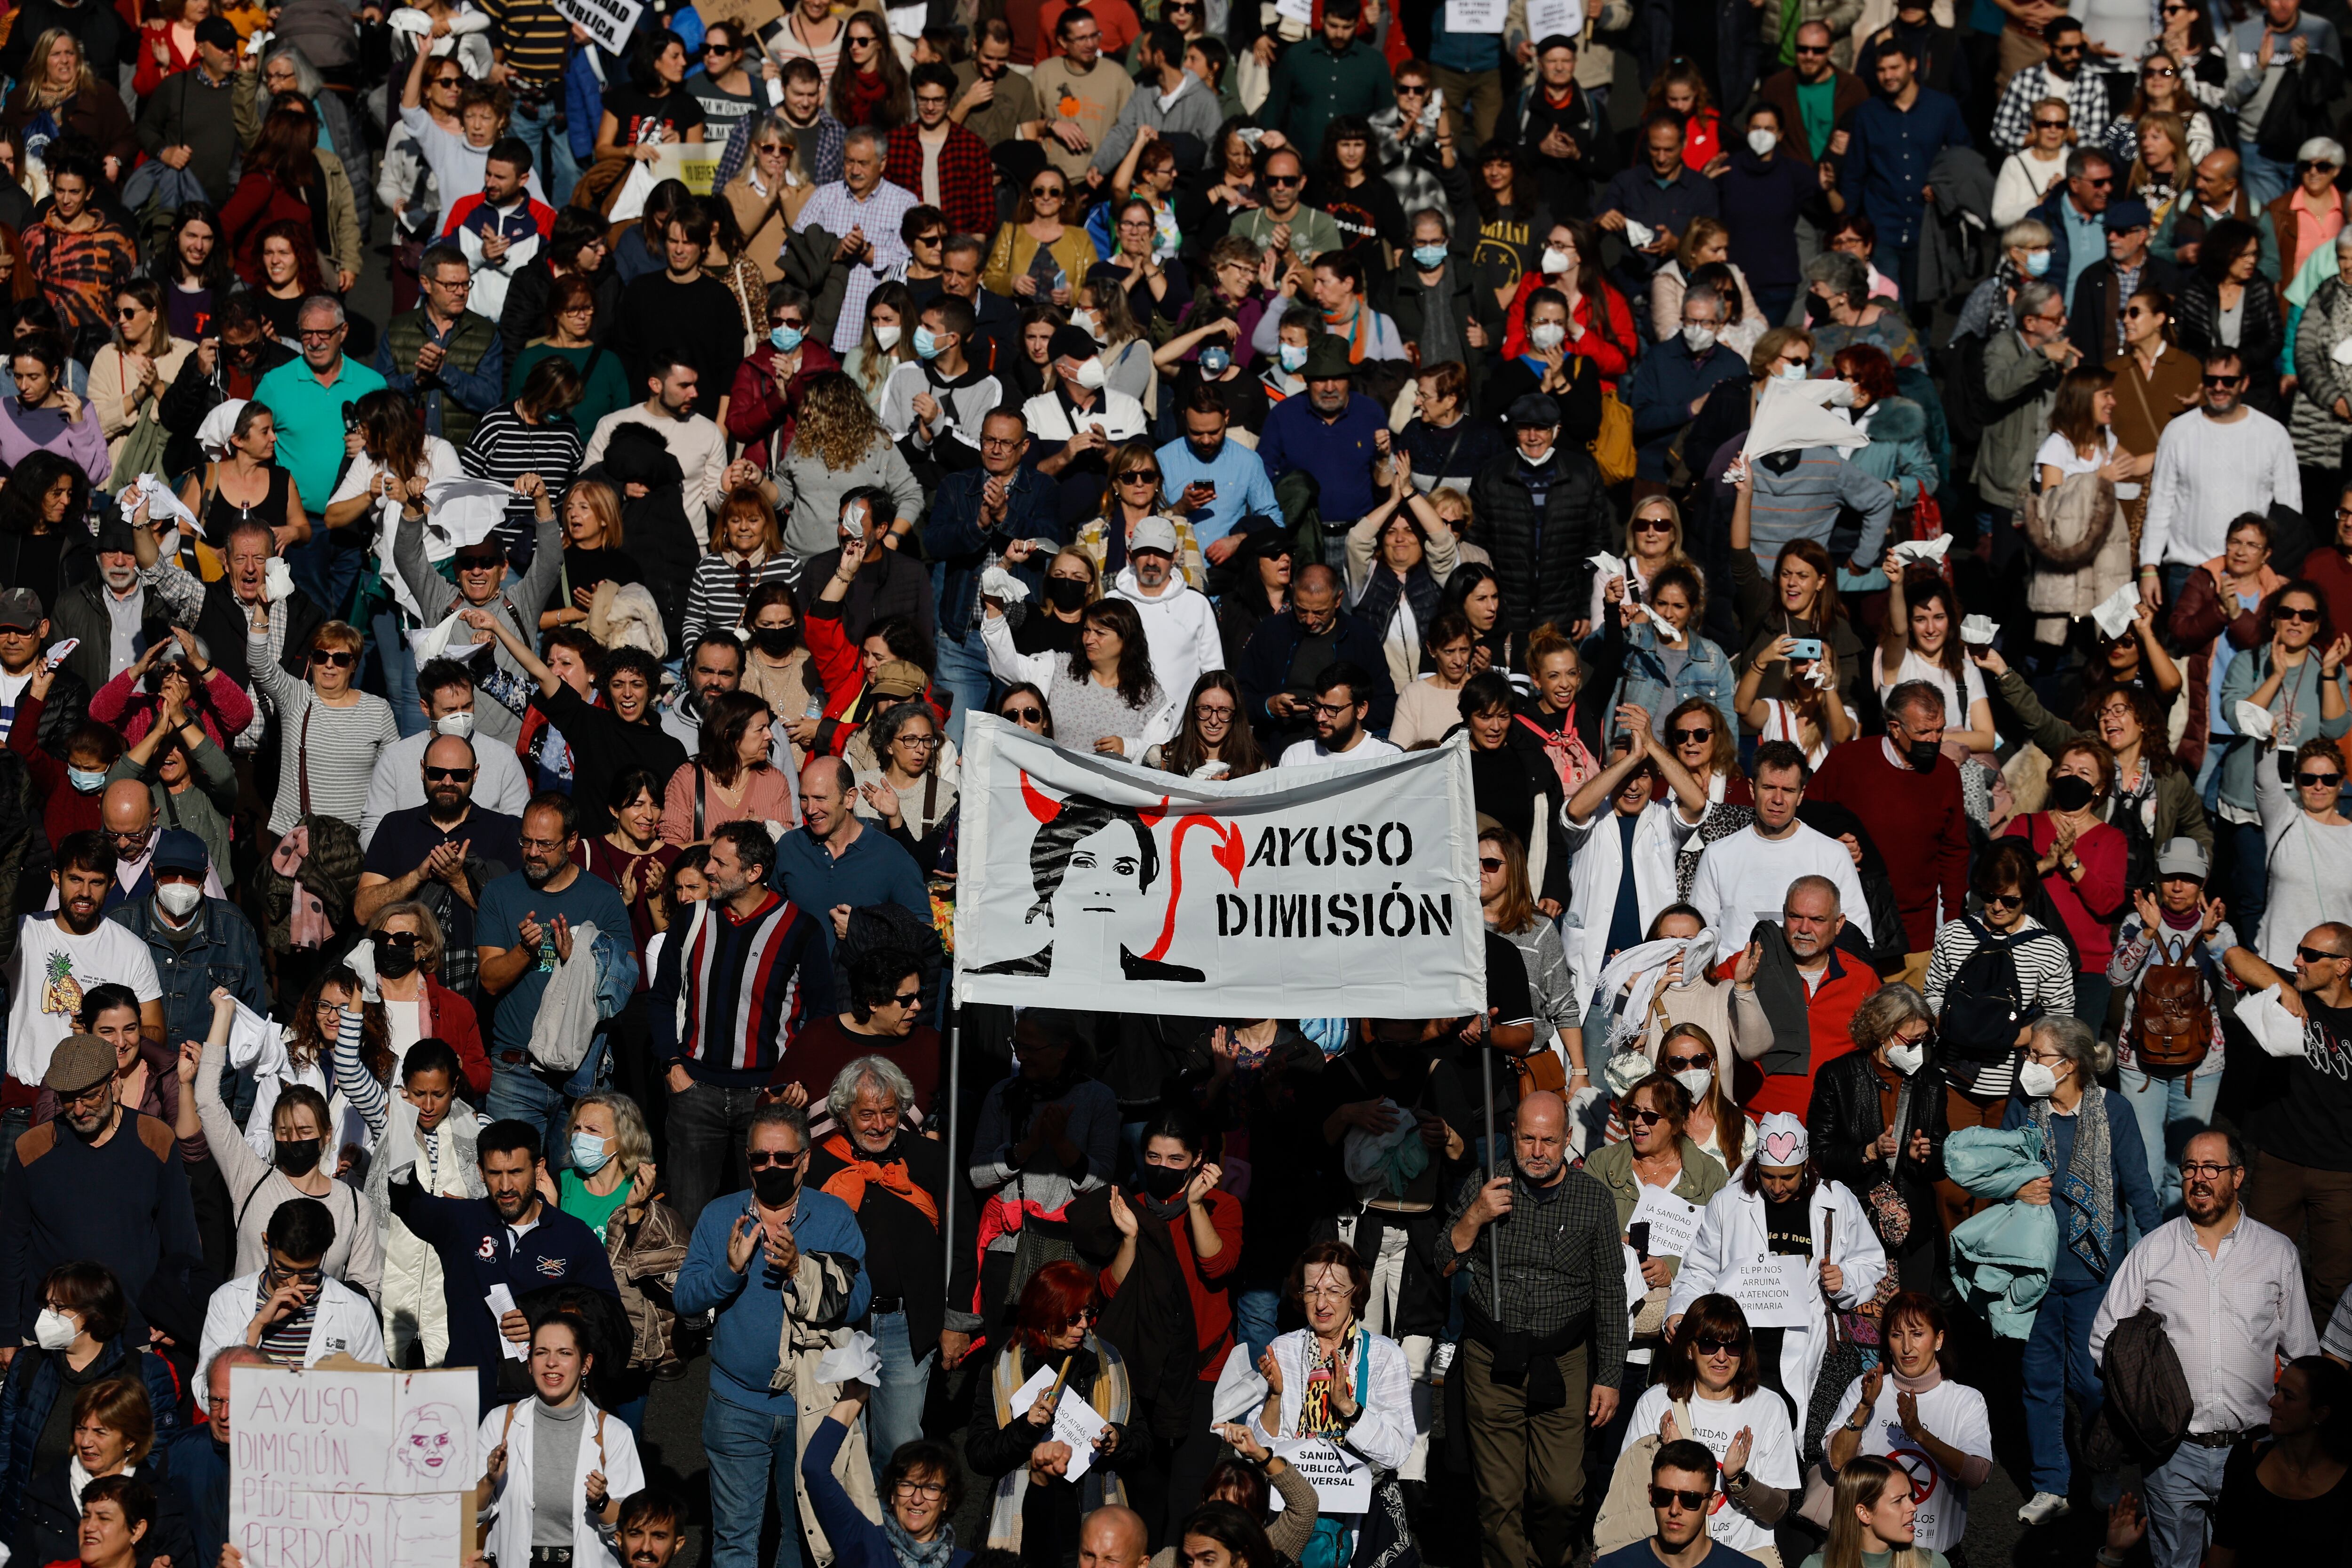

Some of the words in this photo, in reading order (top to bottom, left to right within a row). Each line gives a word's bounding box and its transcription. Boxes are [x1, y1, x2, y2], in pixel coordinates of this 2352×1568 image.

[1247, 822, 1412, 867] AYUSO
[1216, 882, 1452, 937] DIMISIÓN
[1645, 1204, 1654, 1213] LA
[1656, 1209, 1691, 1226] SANIDAD
[1666, 1226, 1692, 1241] VENDE
[479, 1236, 494, 1258] 3
[1747, 1289, 1788, 1298] ATENCION
[249, 1387, 358, 1427] AYUSO
[1059, 1424, 1082, 1448] PUBLICA
[1068, 1418, 1087, 1438] ATRÁS,
[238, 1429, 349, 1475] DIMISIÓN
[1299, 1451, 1342, 1461] SANIDA
[1304, 1477, 1355, 1486] IVERSAL
[242, 1473, 369, 1526] PÍDENOS
[1713, 1522, 1730, 1531] LOS
[1915, 1513, 1935, 1524] LOS
[241, 1522, 373, 1568] PERDÓN
